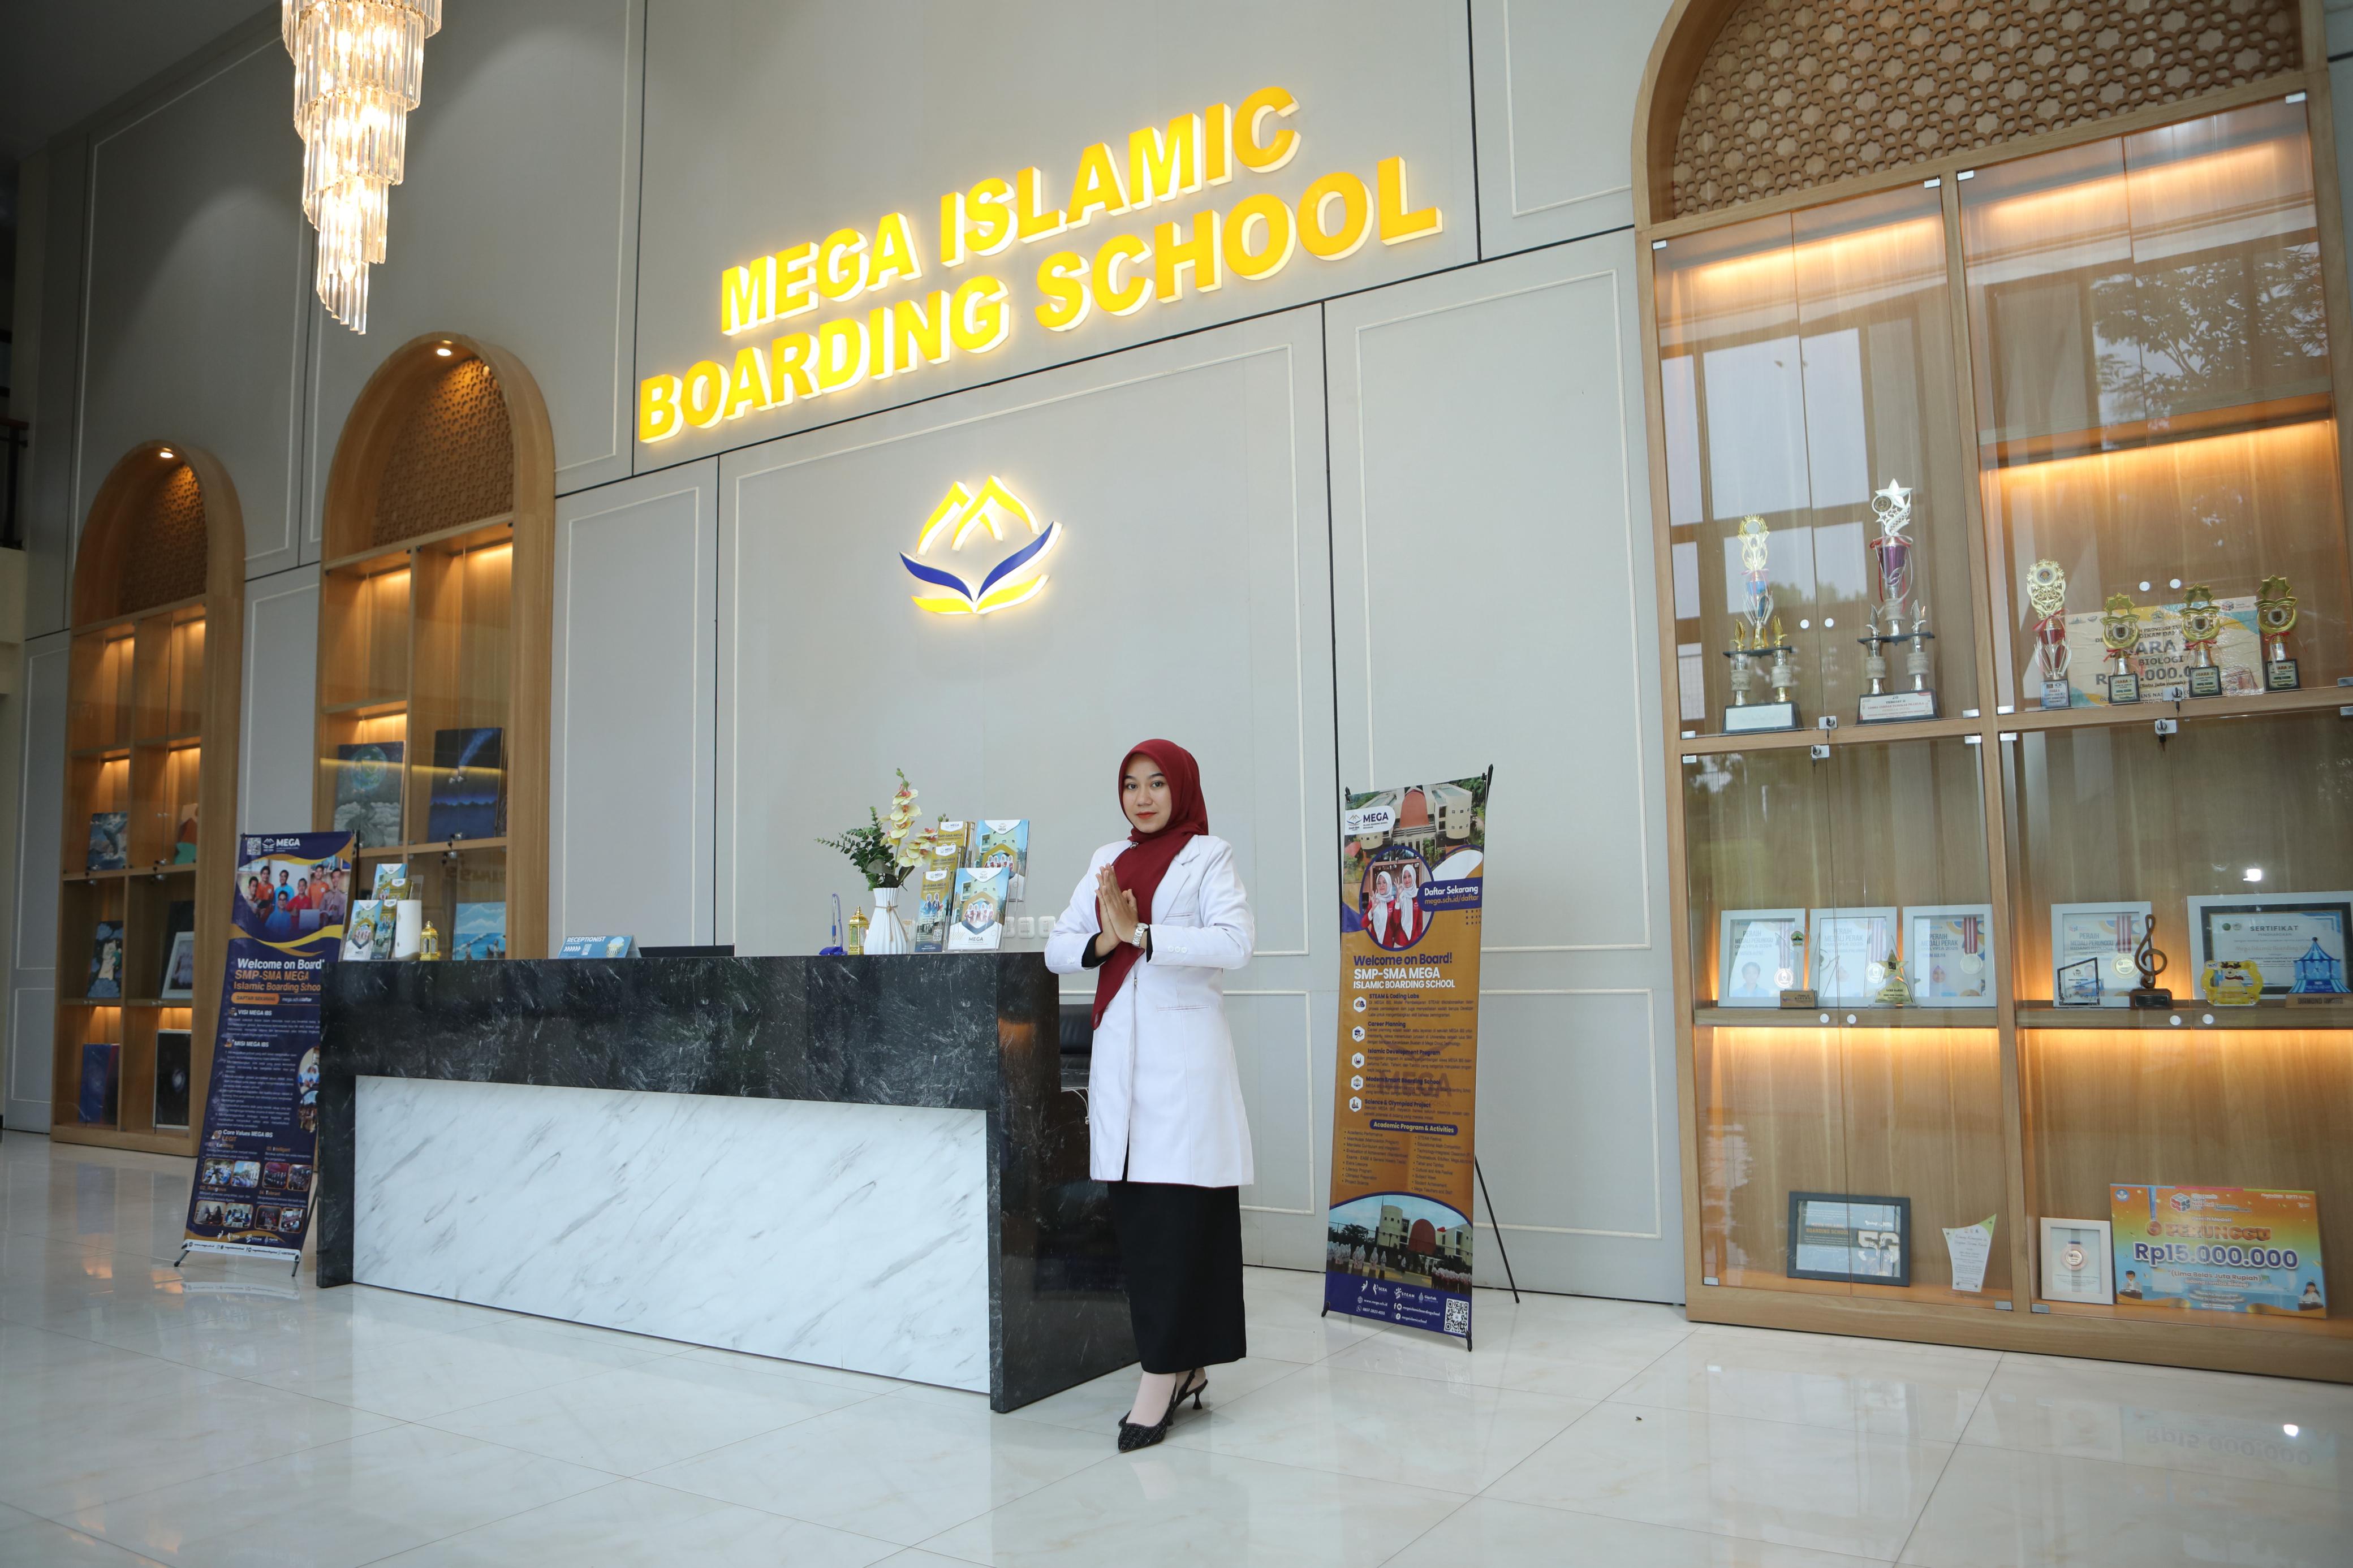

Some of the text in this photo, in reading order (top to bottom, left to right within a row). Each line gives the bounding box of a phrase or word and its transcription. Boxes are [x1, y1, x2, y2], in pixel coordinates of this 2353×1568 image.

[722, 87, 1302, 336] MEGA ISLAMIC
[639, 156, 1443, 444] BOARDING SCHOOL
[2139, 656, 2183, 666] BIOLOGI
[1363, 812, 1389, 823] MEGA
[276, 838, 300, 846] MEGA
[1425, 885, 1478, 896] Daftar Sekarang
[1425, 894, 1479, 905] mega.sch.id/daftar
[238, 958, 282, 969] Welcome
[1354, 952, 1452, 966] Welcome on Board!
[235, 970, 309, 980] SMP-SMA MEGA
[1354, 967, 1440, 979] SMP-SMA MEGA
[234, 981, 321, 993] Islamic Boarding Schoo
[1386, 980, 1424, 988] BOARDING
[1426, 979, 1455, 988] SCHOOL
[2165, 1223, 2272, 1241] PERUNGGU
[2134, 1242, 2298, 1269] Rp15.000.000
